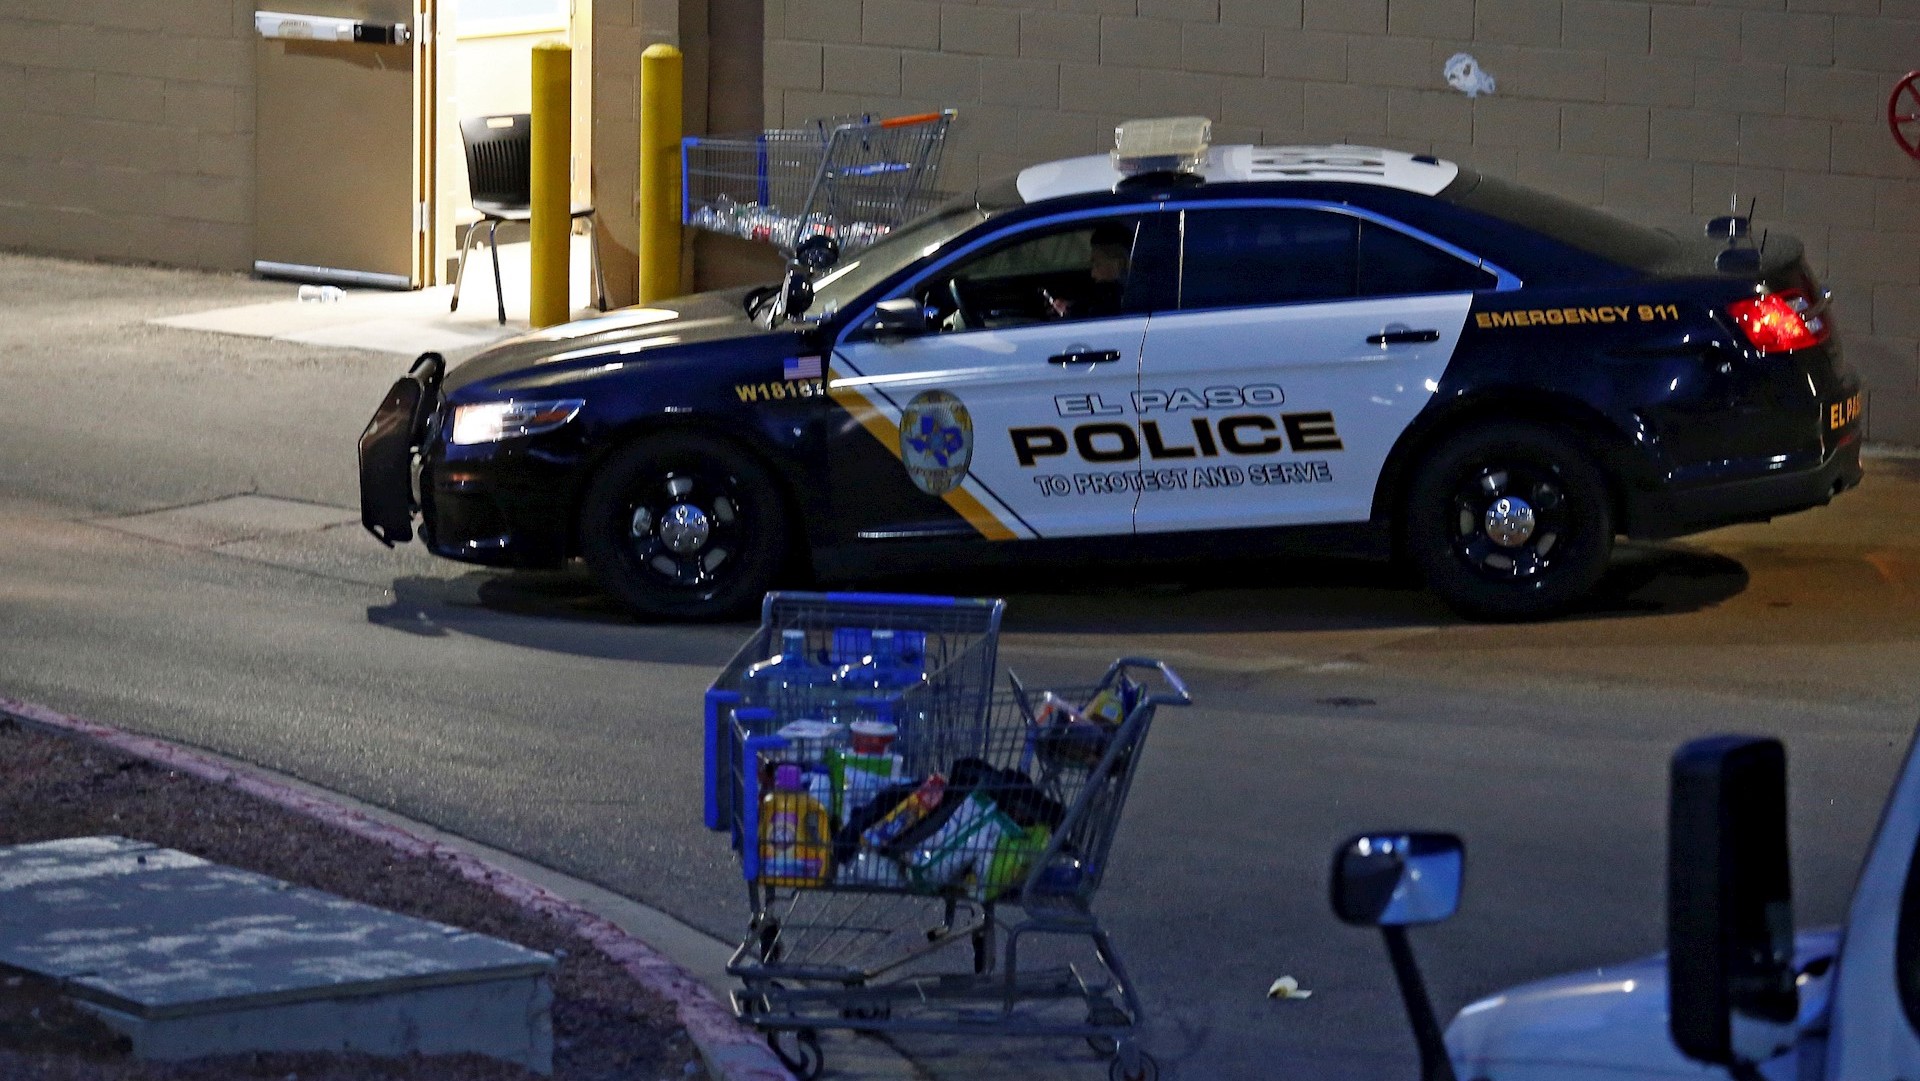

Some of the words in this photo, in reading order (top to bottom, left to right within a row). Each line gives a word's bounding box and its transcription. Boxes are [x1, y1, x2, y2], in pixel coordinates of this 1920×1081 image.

[1475, 305, 1630, 329] EMERGENCY
[1637, 303, 1680, 322] 911
[1054, 393, 1123, 417] EL
[1131, 383, 1285, 413] PASO
[1830, 402, 1846, 430] EL
[1008, 411, 1344, 467] POLICE
[1034, 474, 1071, 497] TO
[1073, 468, 1188, 495] PROTECT
[1192, 464, 1246, 489] AND
[1248, 460, 1333, 485] SERVE
